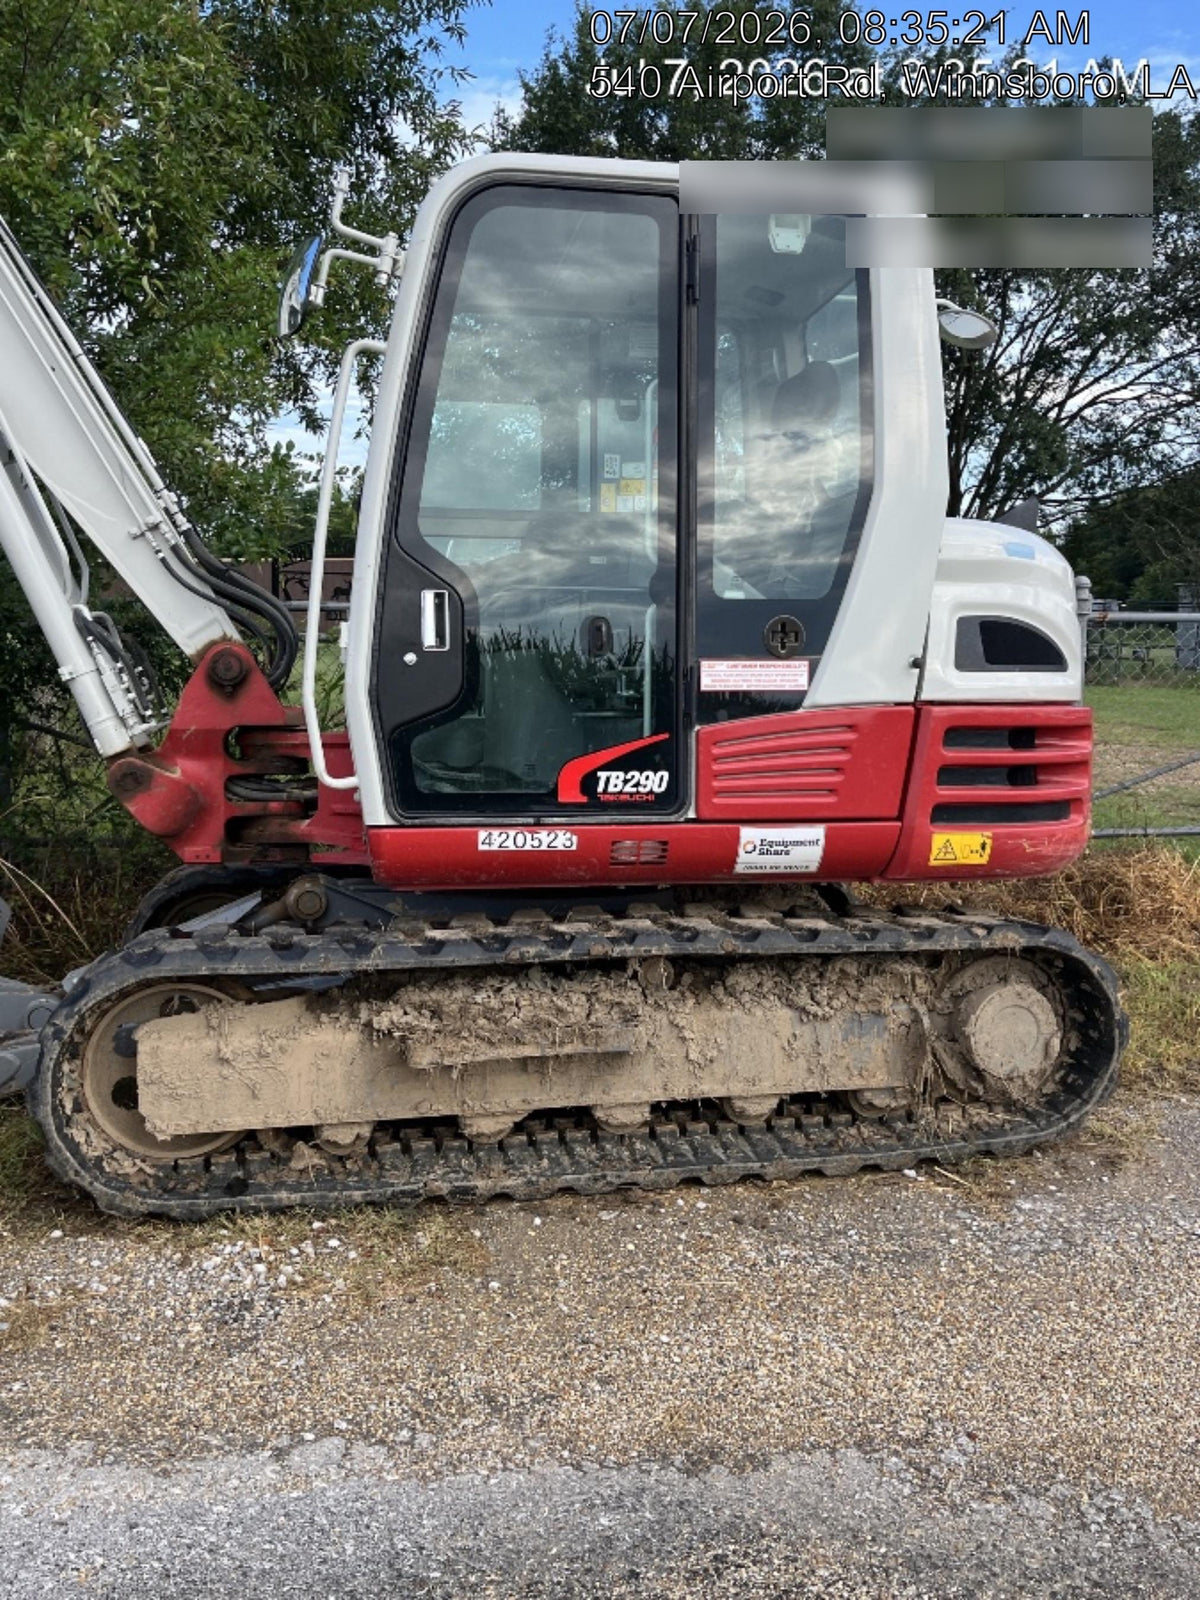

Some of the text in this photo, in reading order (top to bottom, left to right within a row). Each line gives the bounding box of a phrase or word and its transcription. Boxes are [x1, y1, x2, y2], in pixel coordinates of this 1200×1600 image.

[597, 770, 669, 793] TB290
[480, 831, 575, 850] 420523
[759, 839, 821, 849] Equipment
[758, 847, 790, 856] Share
